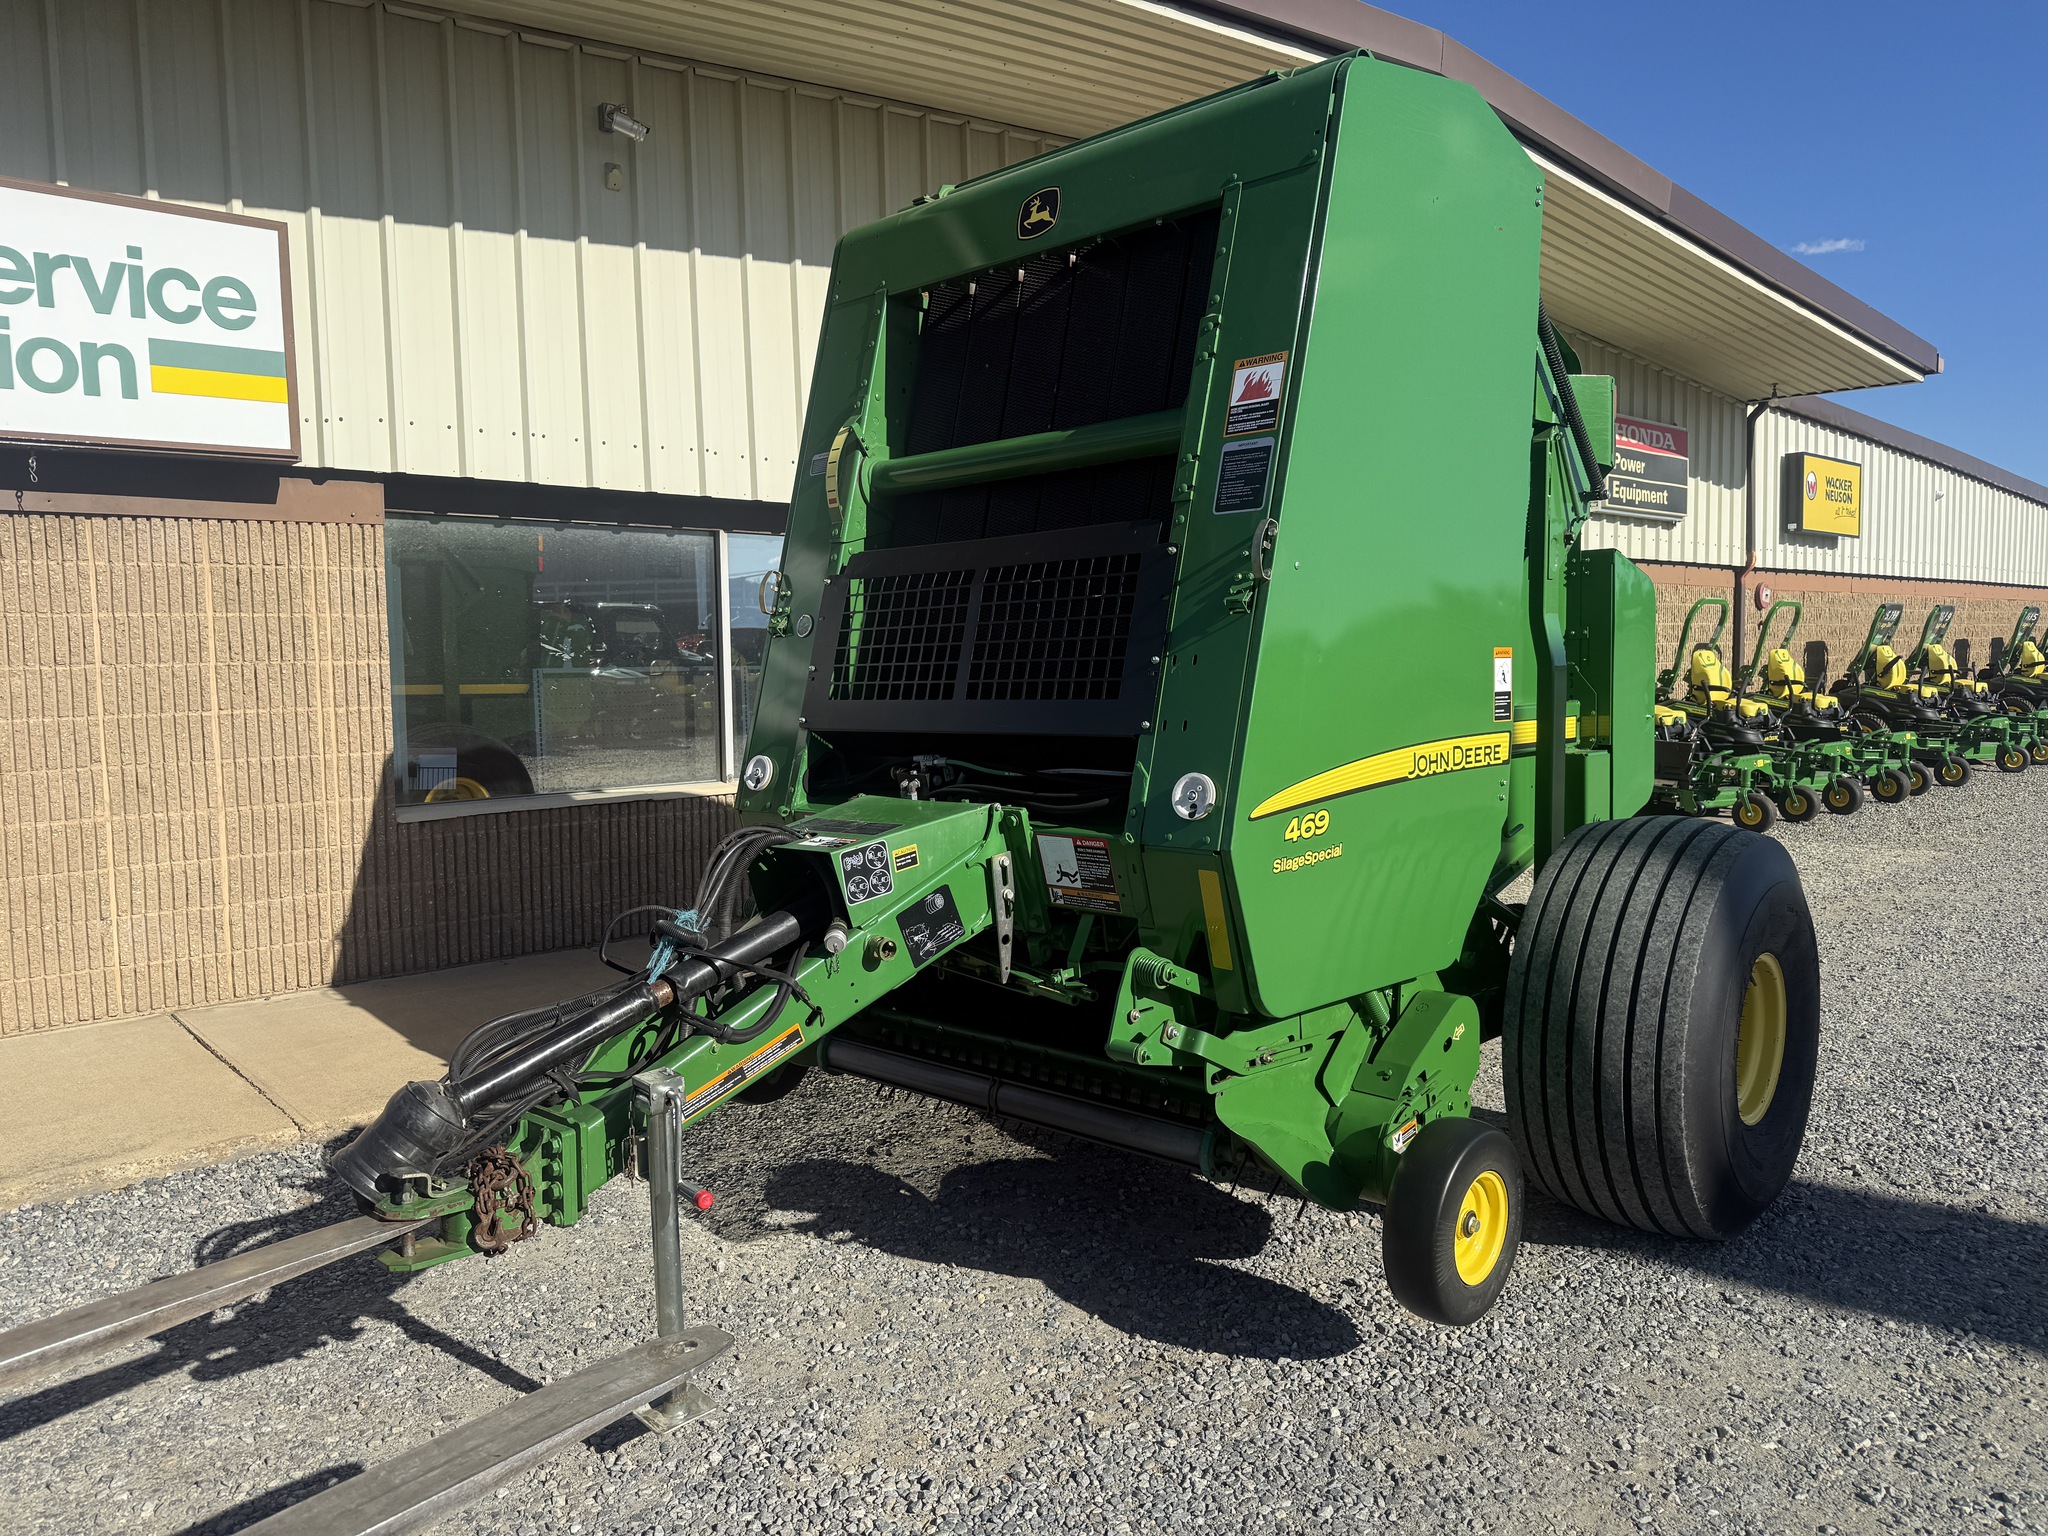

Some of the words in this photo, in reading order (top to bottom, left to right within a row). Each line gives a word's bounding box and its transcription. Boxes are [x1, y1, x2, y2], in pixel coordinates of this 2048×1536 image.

[1245, 353, 1283, 367] WARNING
[1614, 423, 1676, 451] HONDA
[1614, 452, 1646, 474] Power
[1612, 480, 1668, 505] Equipment
[1825, 476, 1853, 492] WACKER
[1825, 489, 1853, 504] NEUSON
[1408, 748, 1450, 776] JOHN
[1452, 744, 1502, 768] DEERE
[1283, 808, 1331, 843] 469
[1082, 840, 1105, 848] DANGER
[1272, 842, 1343, 874] SilageSpecial
